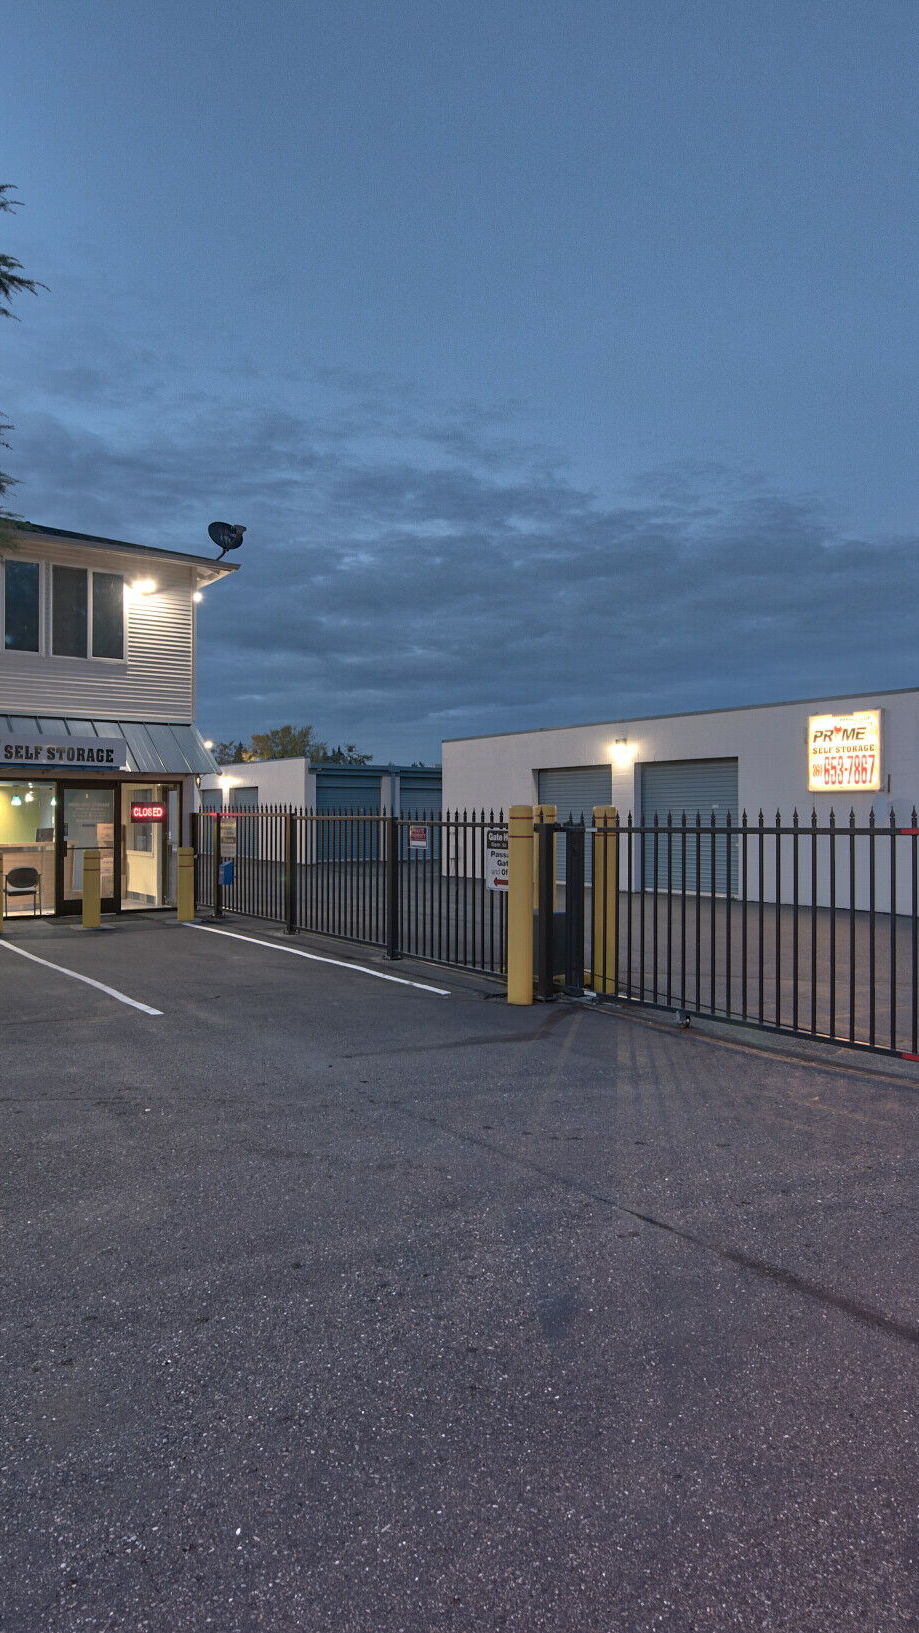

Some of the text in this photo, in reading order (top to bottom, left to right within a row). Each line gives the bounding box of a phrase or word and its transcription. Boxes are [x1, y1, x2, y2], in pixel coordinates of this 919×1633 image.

[813, 726, 866, 743] PRME
[4, 745, 114, 763] SELF STORAGE
[813, 744, 875, 755] SELF STORAGE
[133, 807, 163, 817] CLOSED
[488, 832, 503, 841] Gate
[490, 850, 508, 858] Pass
[497, 859, 508, 867] Gat
